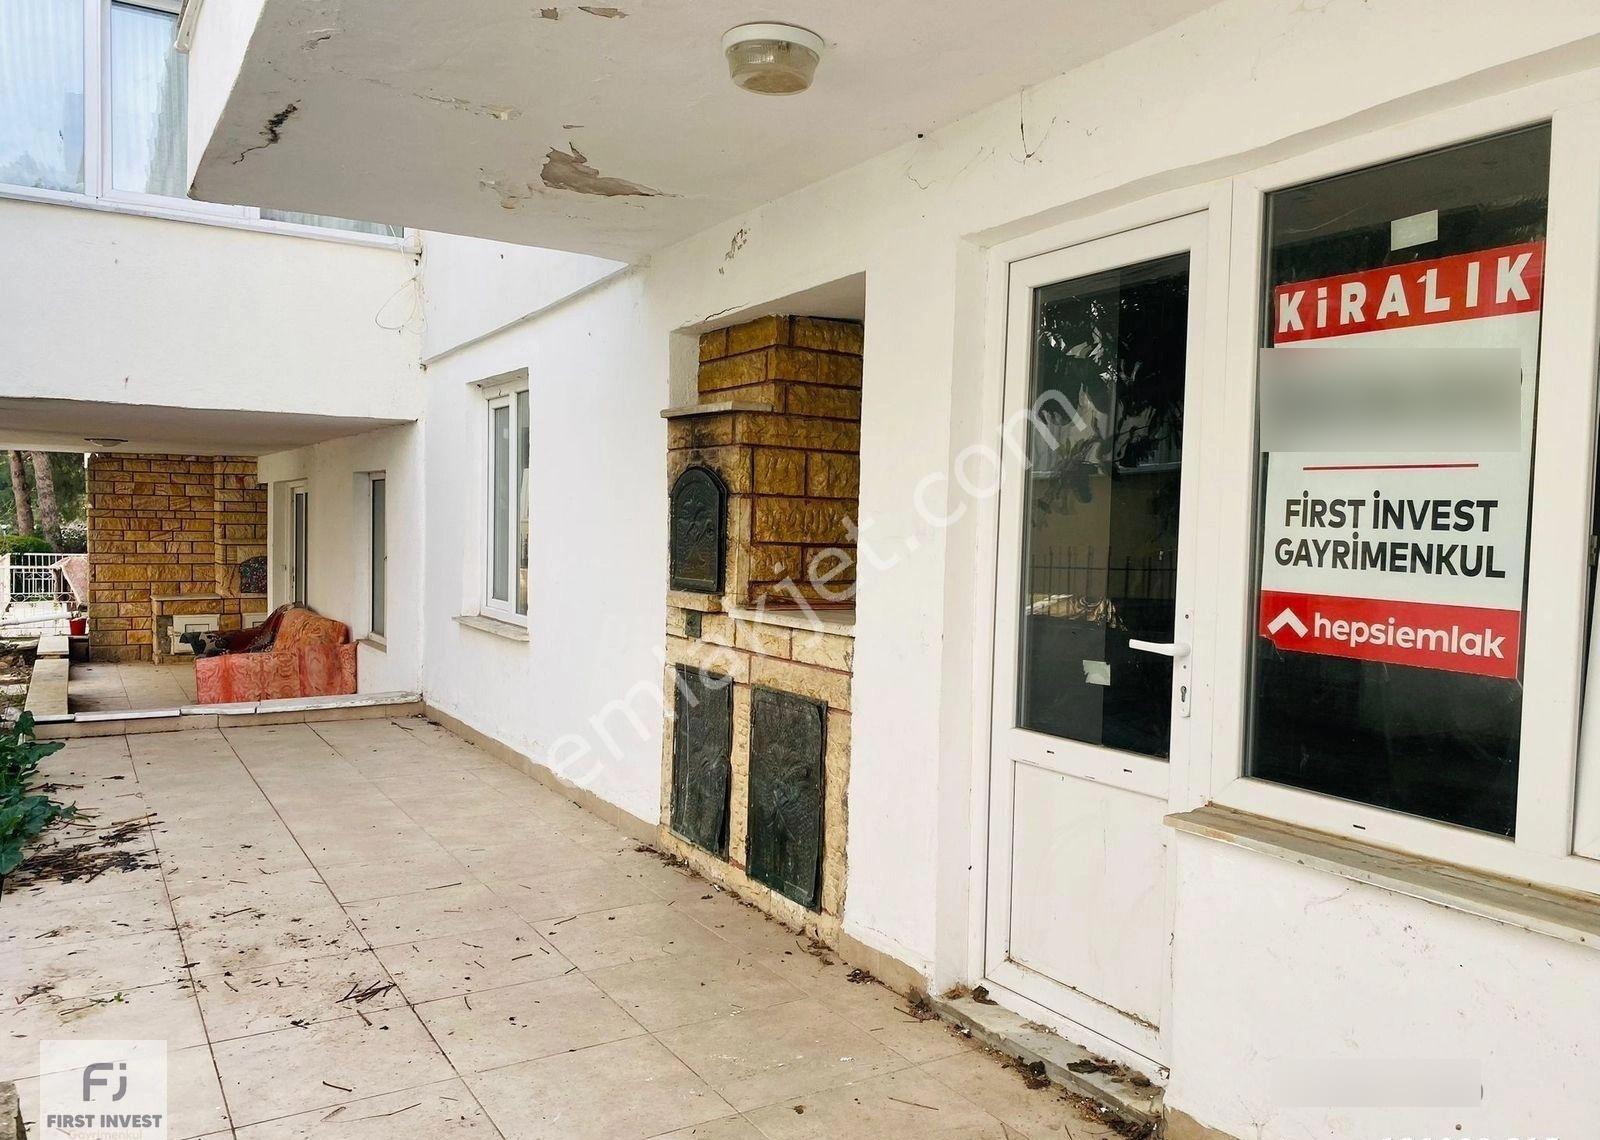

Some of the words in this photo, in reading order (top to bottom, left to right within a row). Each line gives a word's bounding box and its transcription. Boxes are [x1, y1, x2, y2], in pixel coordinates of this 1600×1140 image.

[1284, 490, 1366, 530] FİRST
[1372, 490, 1499, 532] İNVEST
[1274, 532, 1506, 578] GAYRİMENKUL
[1314, 612, 1506, 658] hepsiemlak
